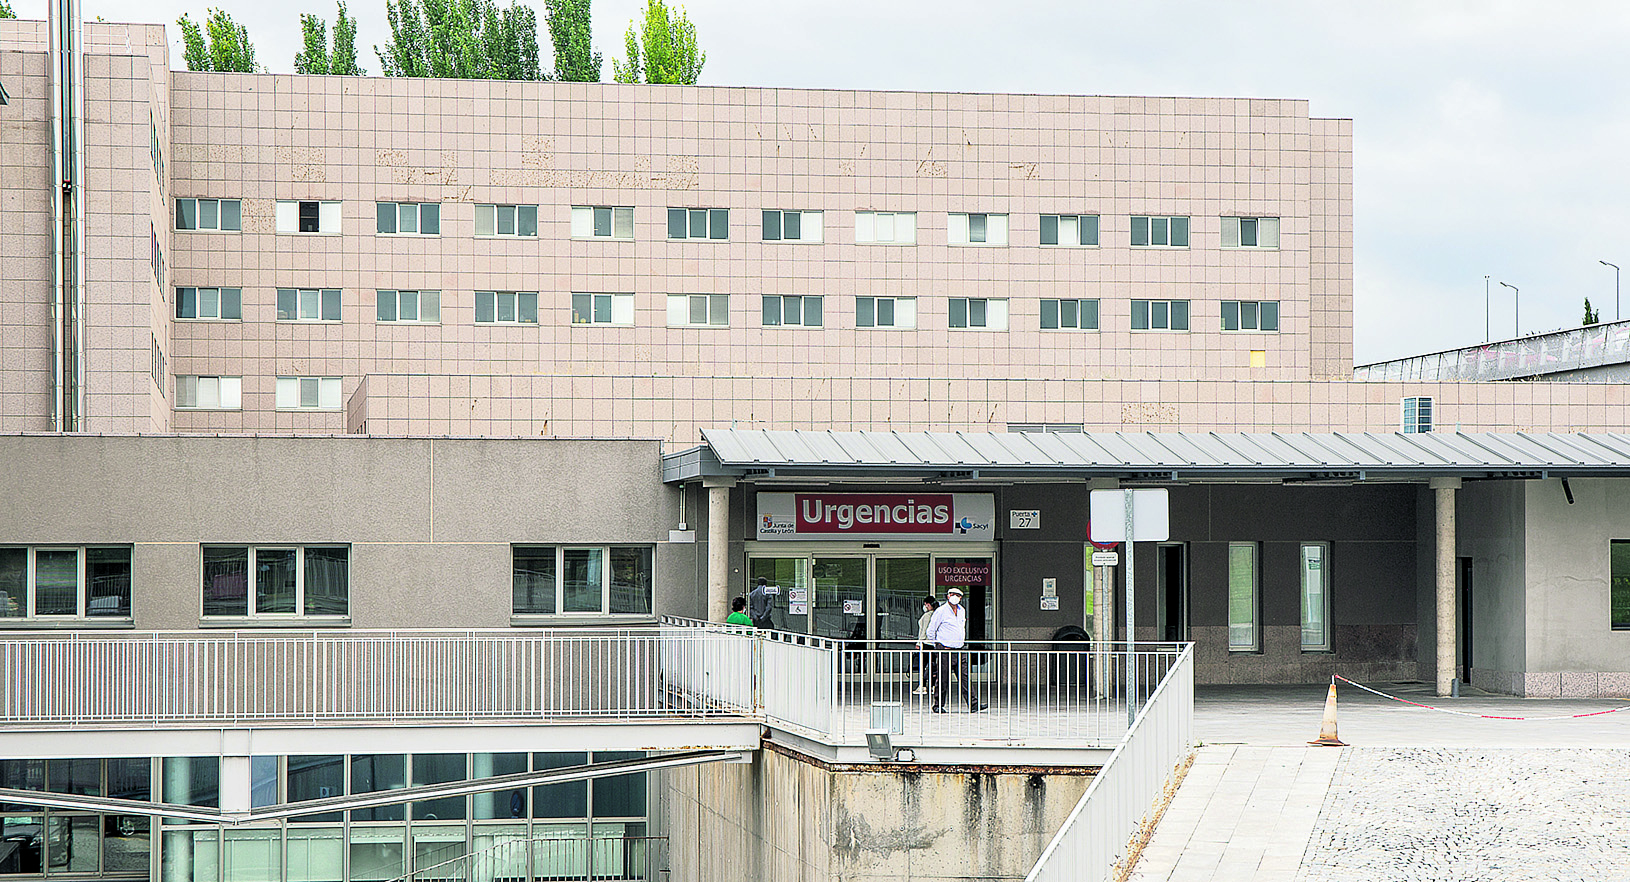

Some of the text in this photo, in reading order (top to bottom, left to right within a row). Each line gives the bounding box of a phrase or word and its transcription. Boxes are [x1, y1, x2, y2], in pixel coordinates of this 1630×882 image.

[802, 499, 949, 529] Urgencias
[1018, 517, 1031, 527] 27
[938, 566, 989, 574] USO EXCLUSIVO
